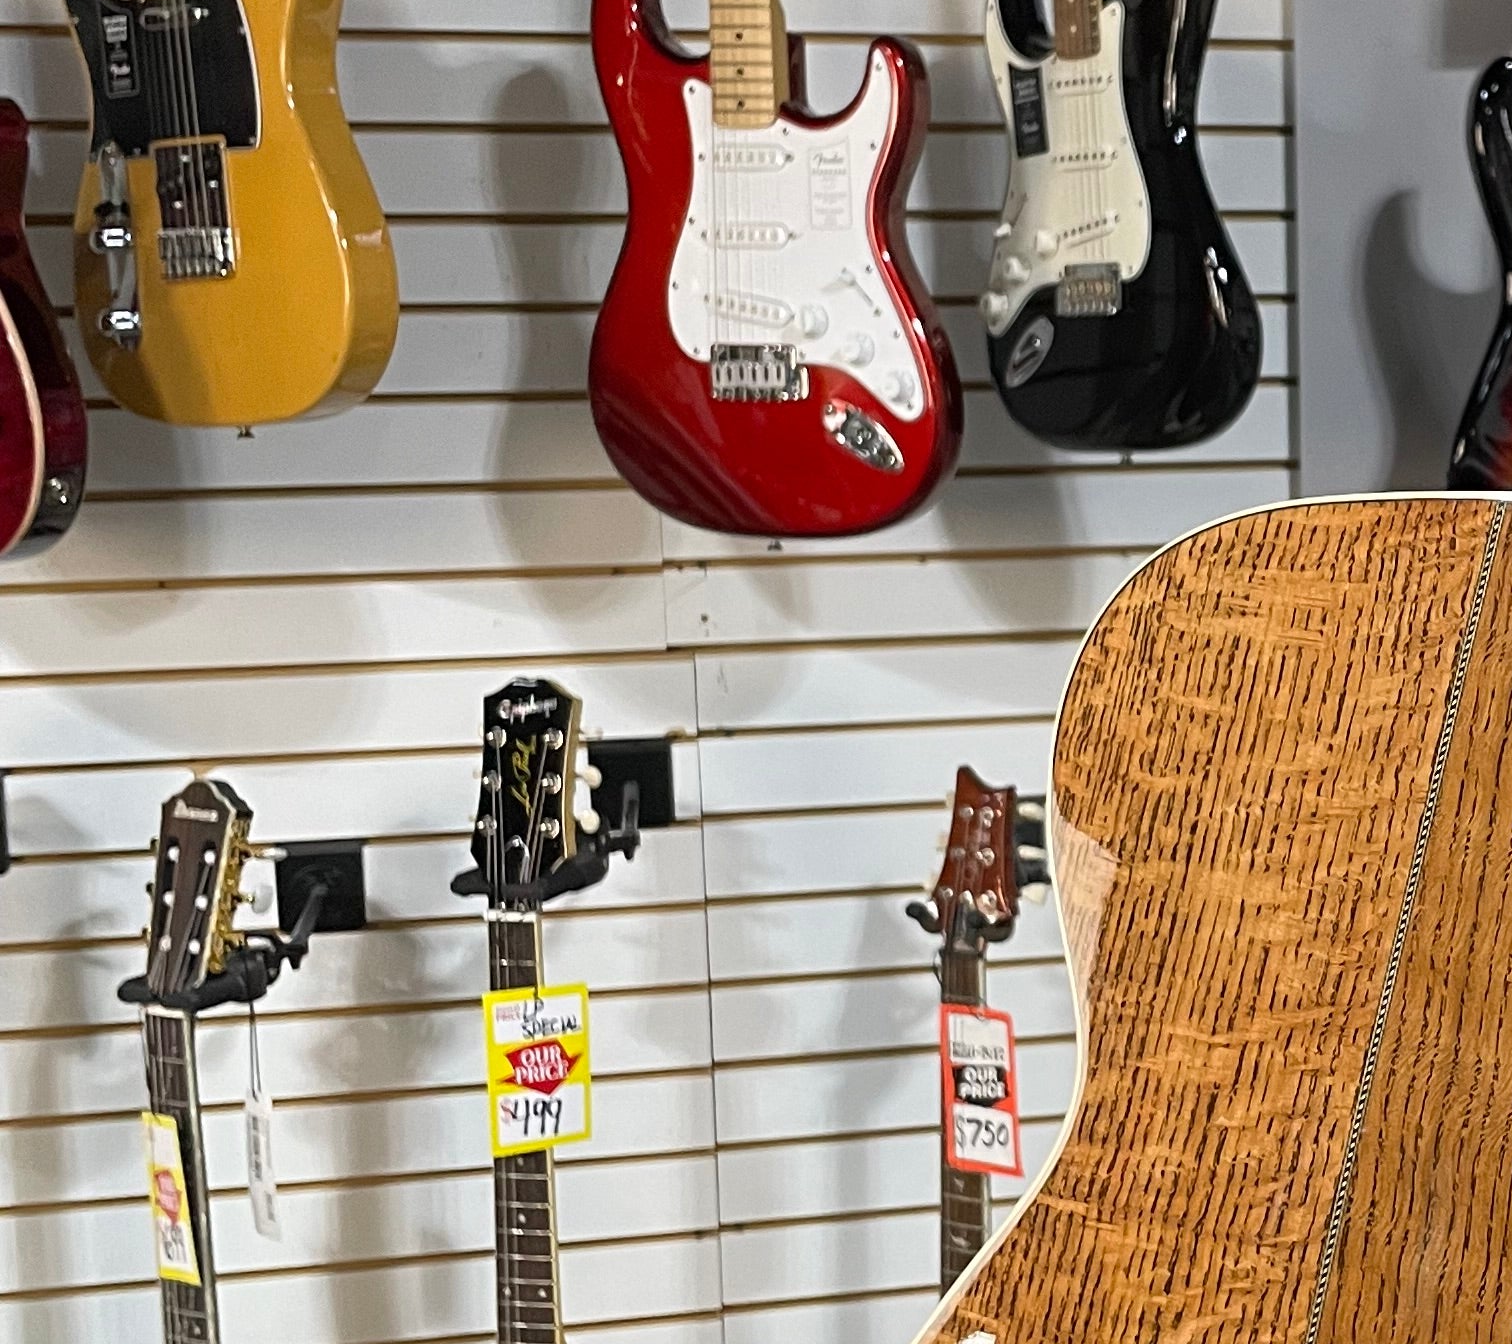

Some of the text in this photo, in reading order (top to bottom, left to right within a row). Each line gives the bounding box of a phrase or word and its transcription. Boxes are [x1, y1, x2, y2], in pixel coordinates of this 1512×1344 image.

[520, 1044, 562, 1067] OUR
[514, 1060, 570, 1086] PRICE
[963, 1065, 999, 1082] OUR
[959, 1080, 1006, 1099] PRICE
[955, 1115, 1010, 1153] $750
